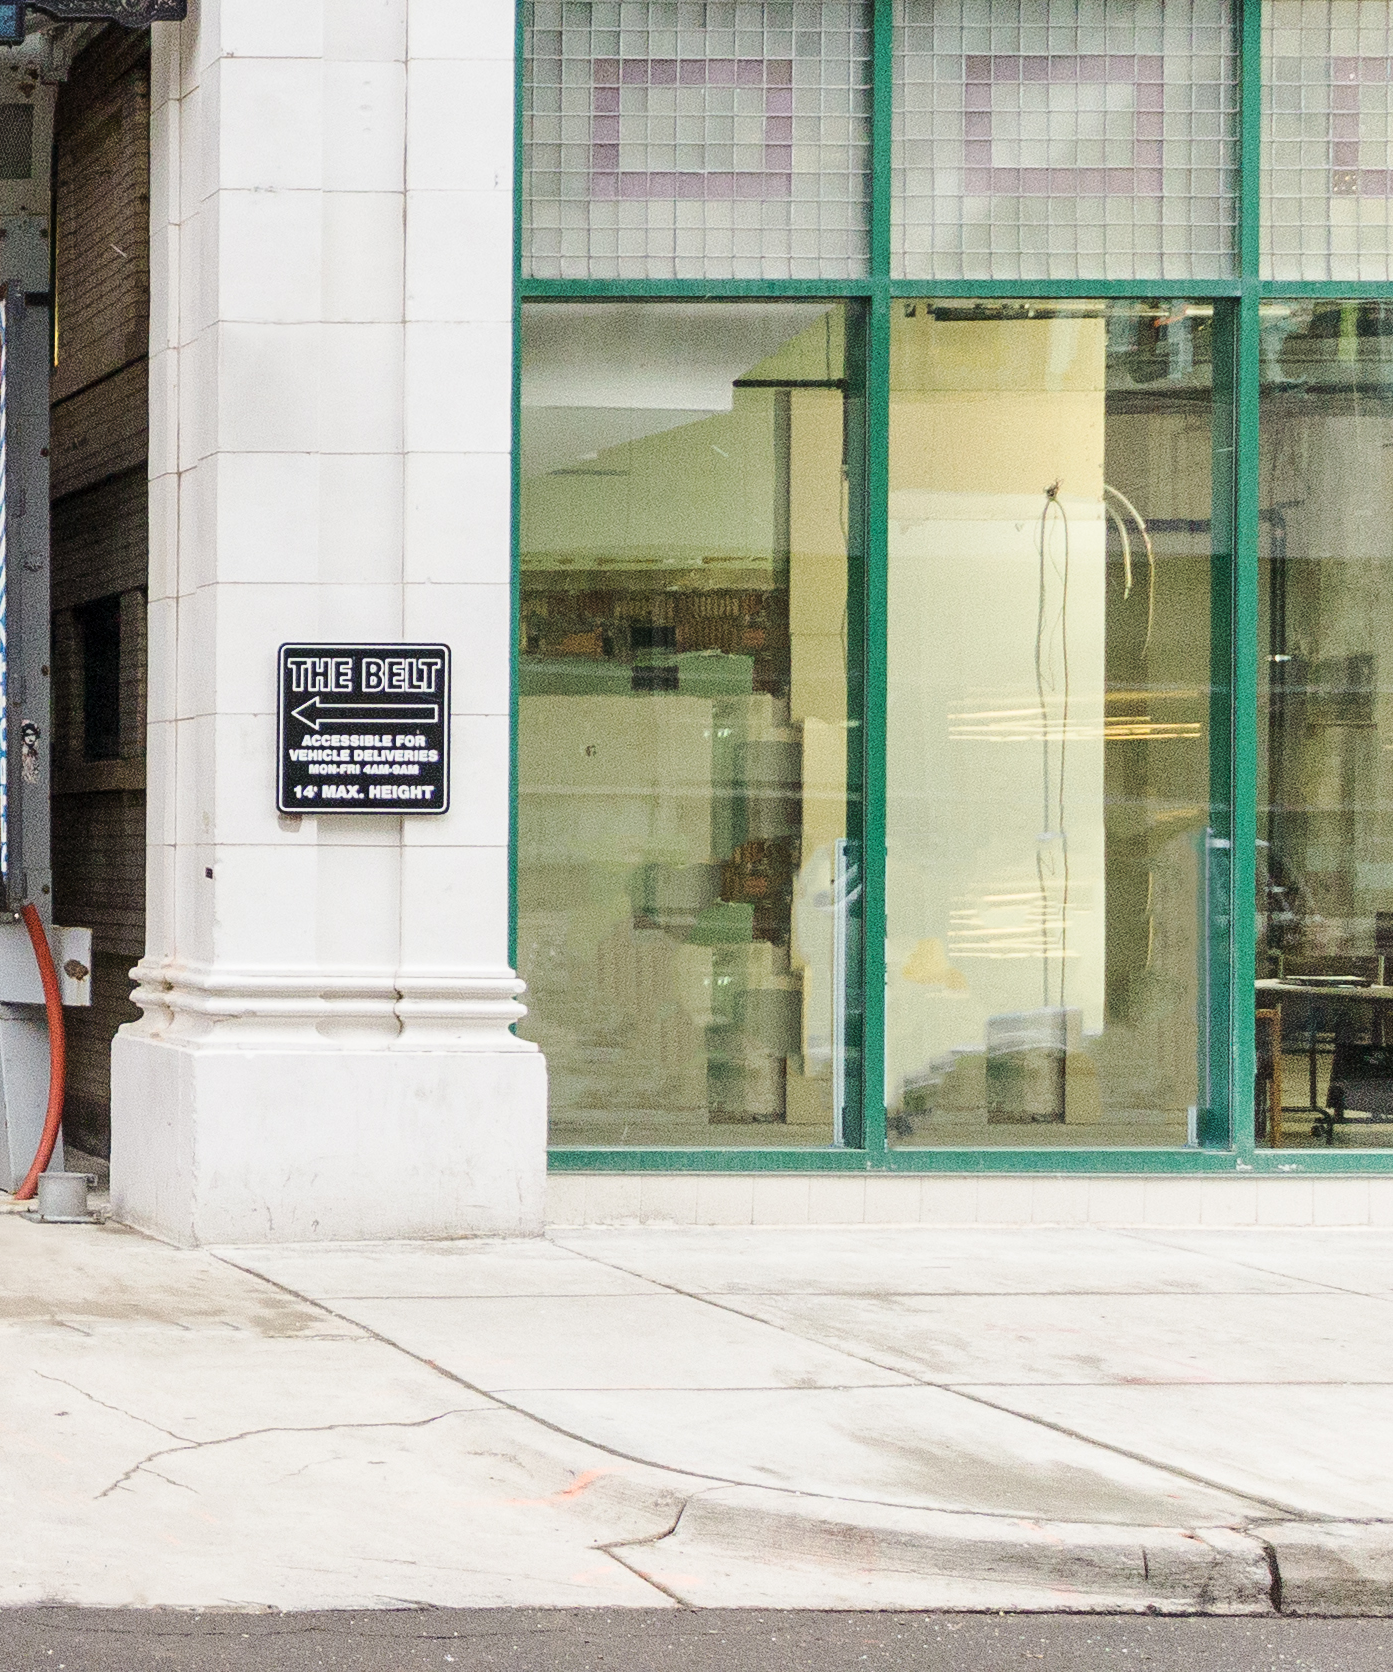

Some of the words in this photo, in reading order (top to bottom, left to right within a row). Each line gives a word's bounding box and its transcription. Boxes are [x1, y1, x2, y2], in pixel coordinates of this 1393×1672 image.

[288, 658, 352, 692] THE
[362, 659, 441, 692] BELT
[302, 735, 393, 747] ACCESSIBLE
[396, 735, 426, 747] FOR
[289, 750, 350, 761] VEHICLE
[354, 750, 438, 762] DELIVERIES
[309, 764, 360, 774] MON-FRI
[363, 764, 419, 775] 4AM-9AM
[294, 785, 318, 798] 14'
[322, 785, 364, 799] MAX.
[369, 785, 434, 799] HEIGHT
